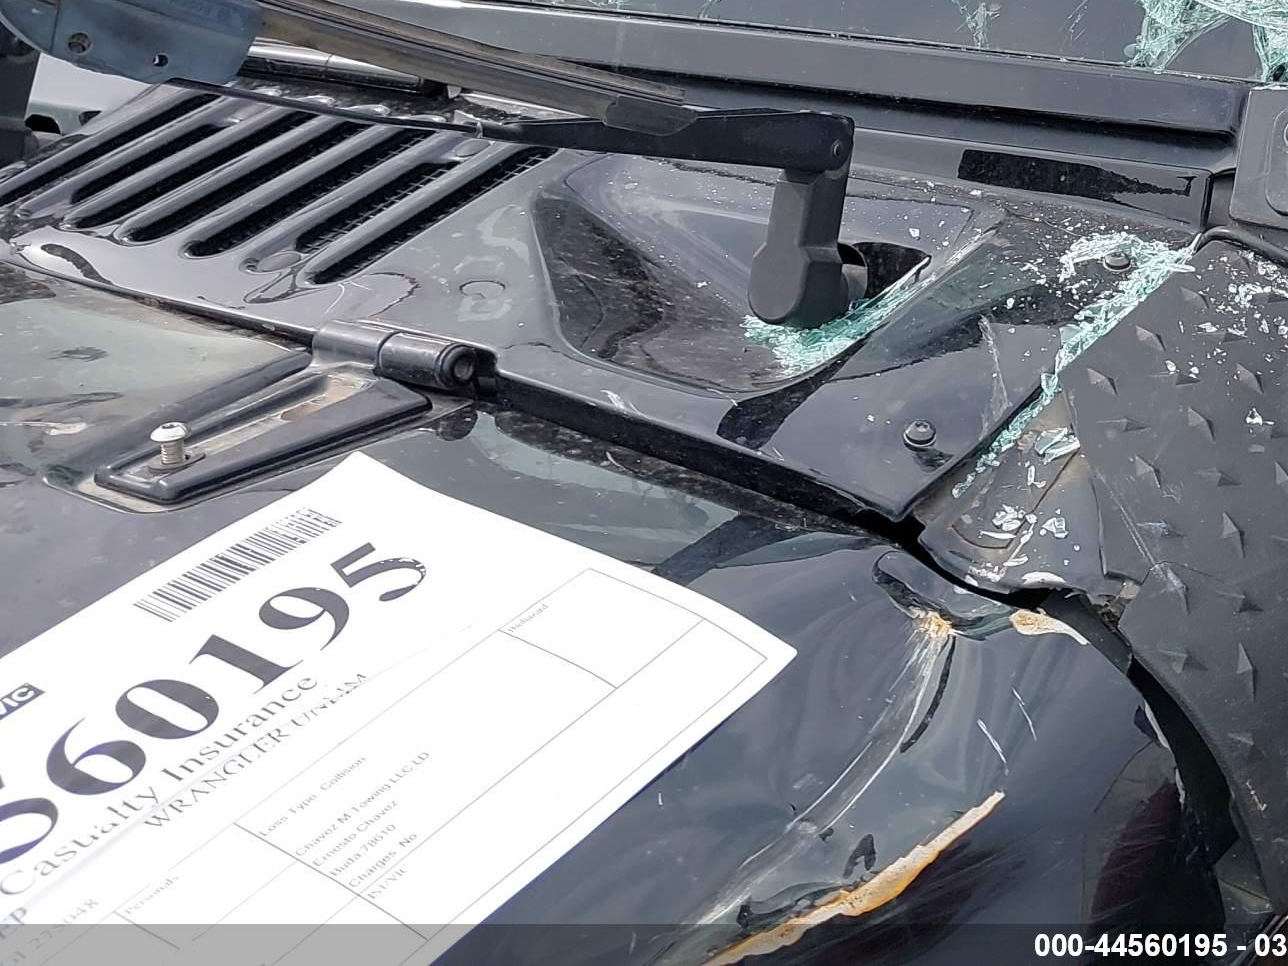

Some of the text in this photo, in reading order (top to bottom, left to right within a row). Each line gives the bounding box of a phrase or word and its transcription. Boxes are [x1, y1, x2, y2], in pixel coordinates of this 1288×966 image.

[0, 676, 318, 896] Casualty Insurance
[145, 727, 291, 828] WRANGLER
[258, 815, 289, 837] Loss
[319, 755, 367, 791] Collision
[295, 822, 339, 857] Chavez
[350, 782, 392, 814] Towing
